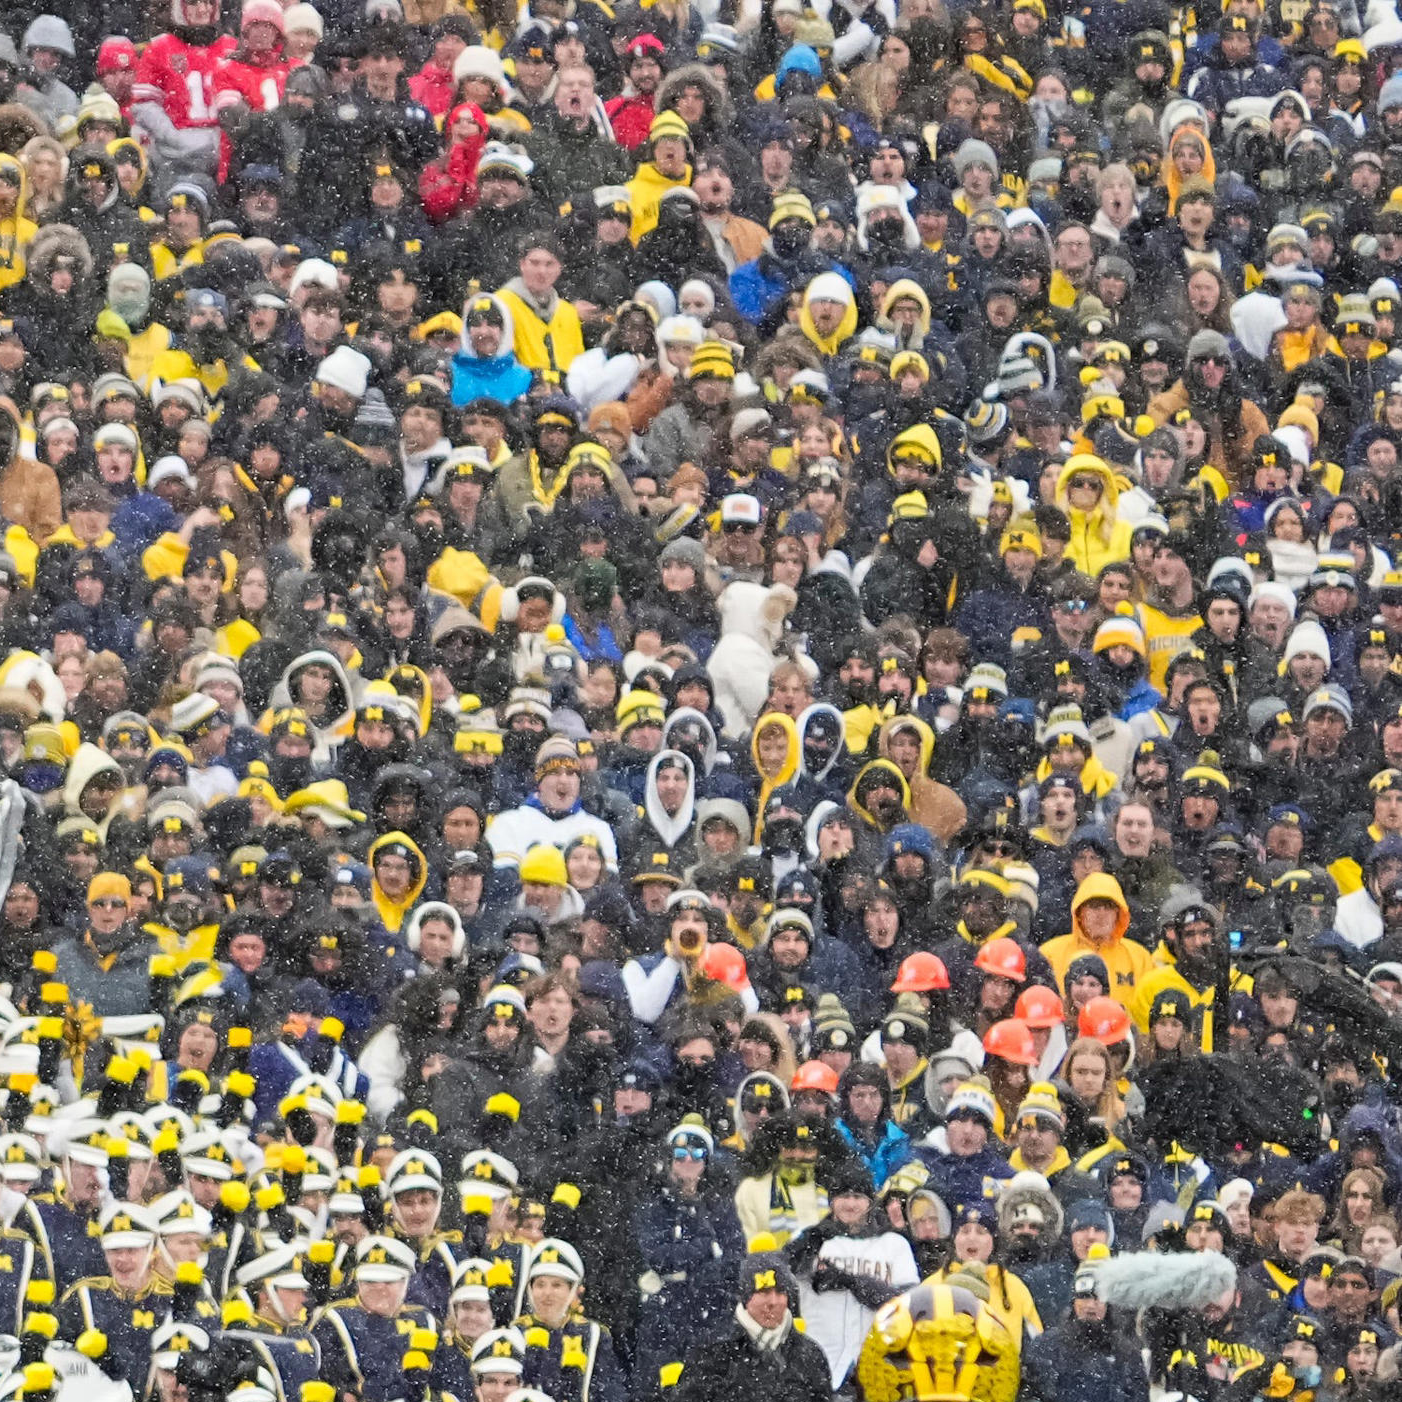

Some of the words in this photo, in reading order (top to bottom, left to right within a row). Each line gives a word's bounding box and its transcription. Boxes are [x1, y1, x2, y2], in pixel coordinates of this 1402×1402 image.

[1116, 971, 1135, 987] M
[134, 1310, 153, 1326] M
[1297, 1322, 1314, 1337] M
[1360, 1332, 1376, 1343] M
